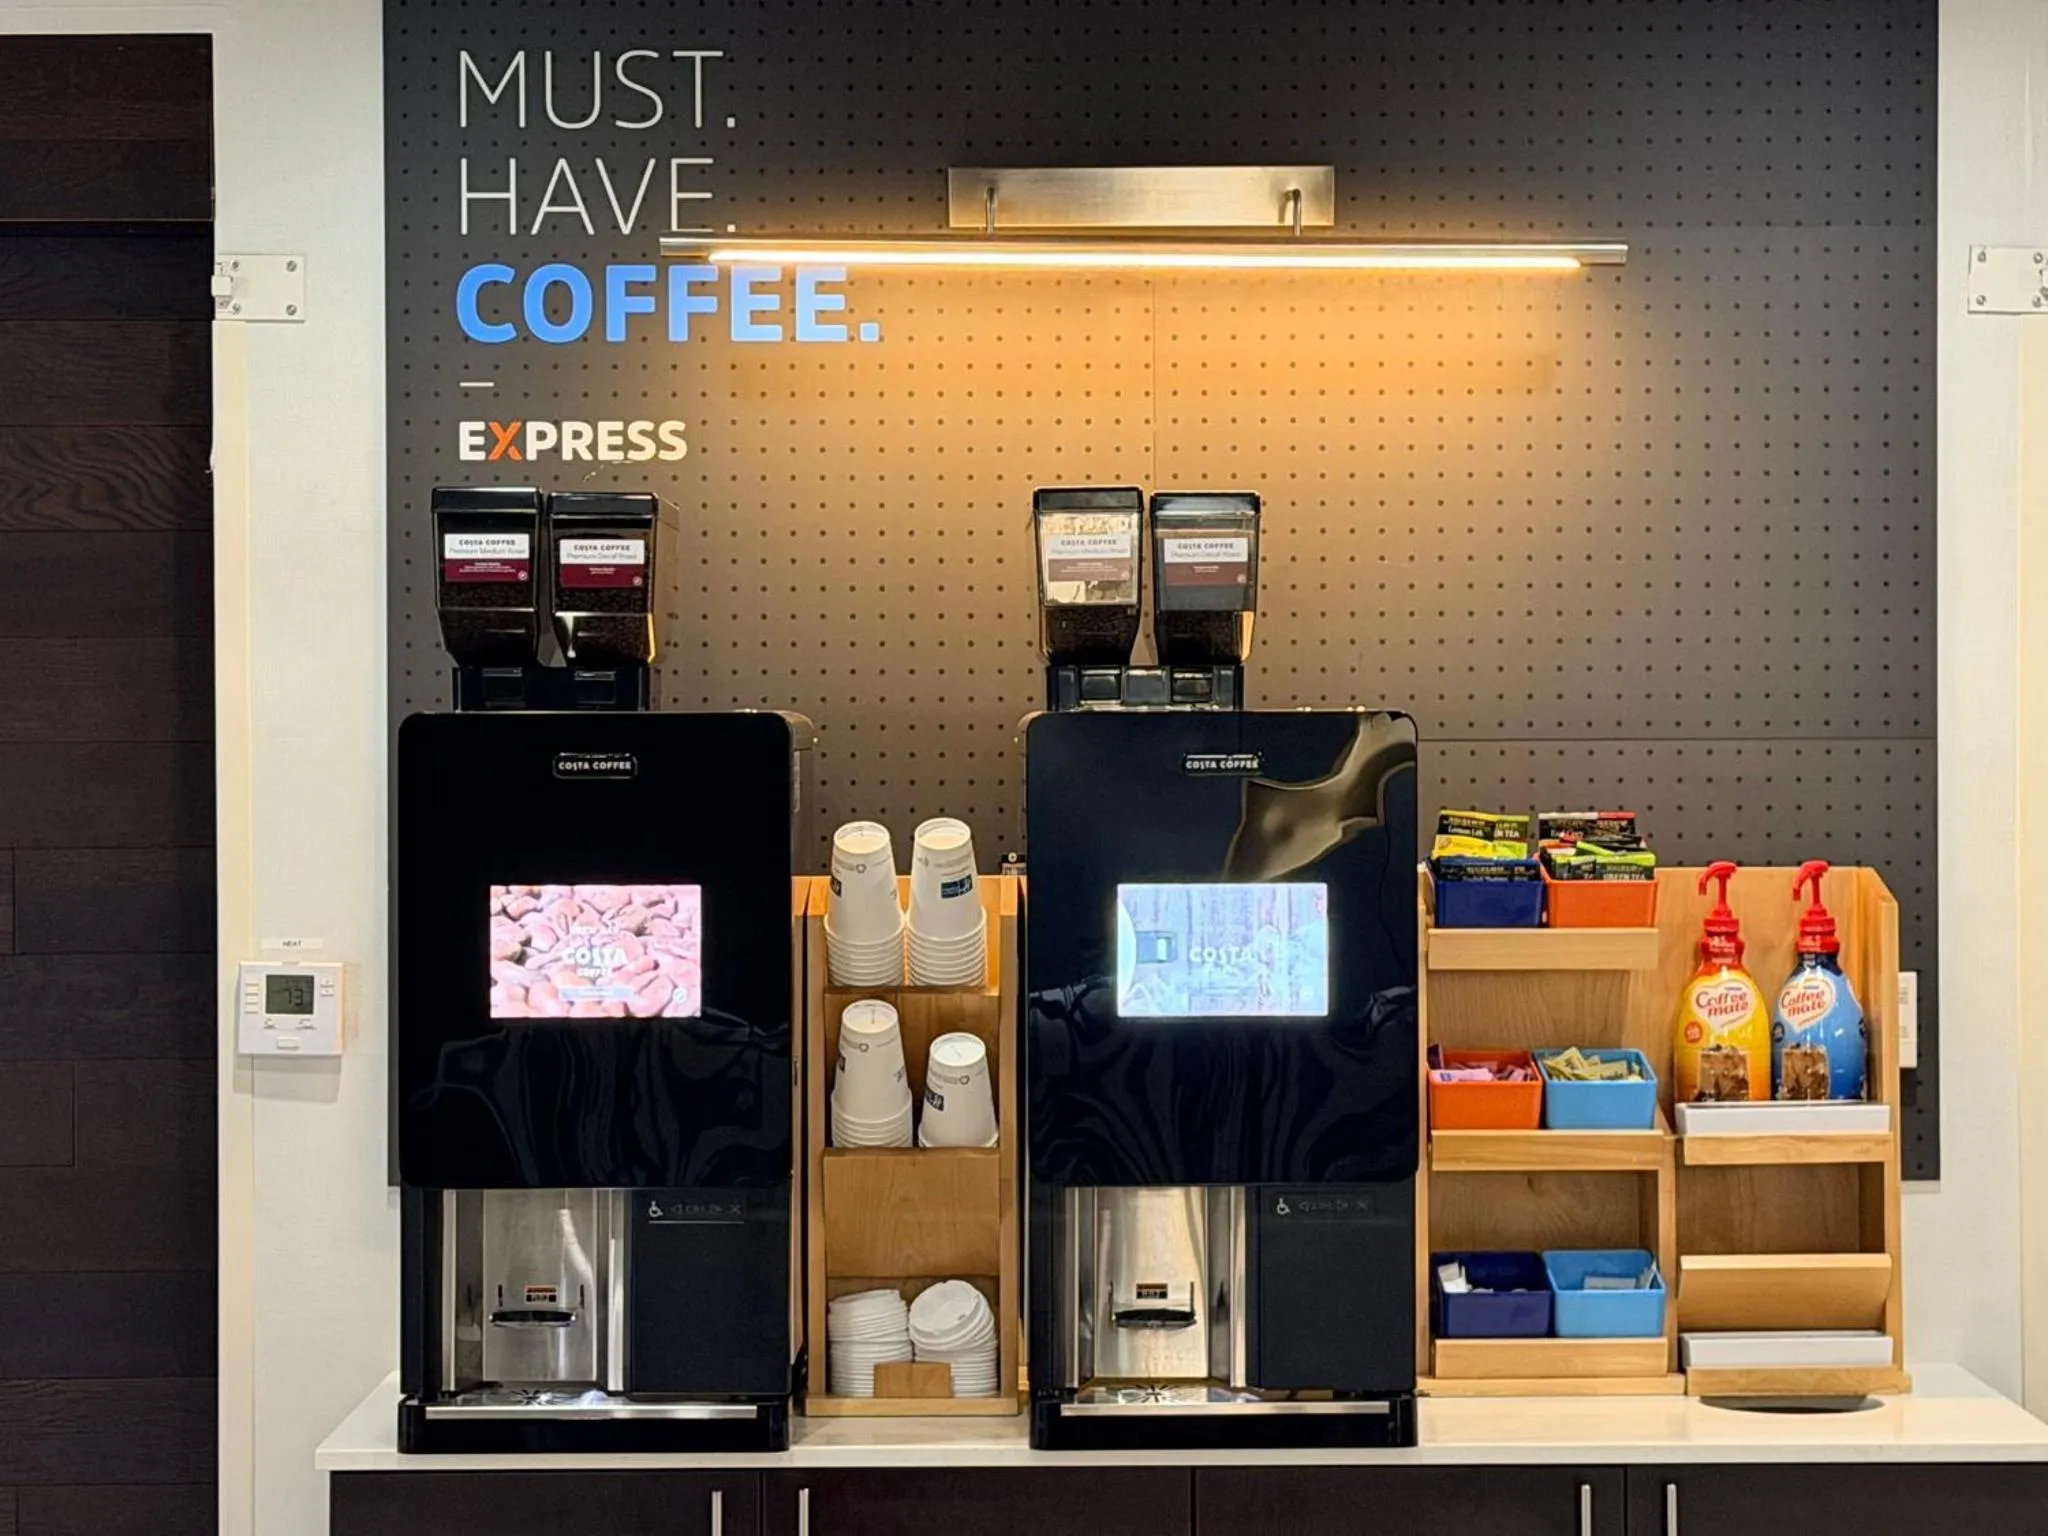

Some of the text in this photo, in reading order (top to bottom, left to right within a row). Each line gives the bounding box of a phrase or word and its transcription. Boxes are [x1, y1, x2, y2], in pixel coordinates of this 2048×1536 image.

[460, 50, 735, 128] MUST.
[460, 158, 735, 235] HAVE.
[456, 263, 880, 343] COFFEE.
[459, 420, 687, 461] EXPRESS
[458, 539, 483, 547] COSTA
[573, 544, 598, 552] COSTA
[1060, 539, 1085, 547] COSTA
[558, 761, 632, 771] COSTA COFFEE
[1185, 760, 1259, 770] COSTA COFFEE
[1504, 829, 1521, 838] TEA
[561, 946, 629, 968] COSTA
[1189, 946, 1254, 966] COSTA
[282, 987, 304, 1007] 73
[1695, 991, 1748, 1009] Coffee
[1780, 990, 1825, 1009] Coffee
[1707, 1001, 1749, 1017] mate
[1787, 1000, 1826, 1017] mate
